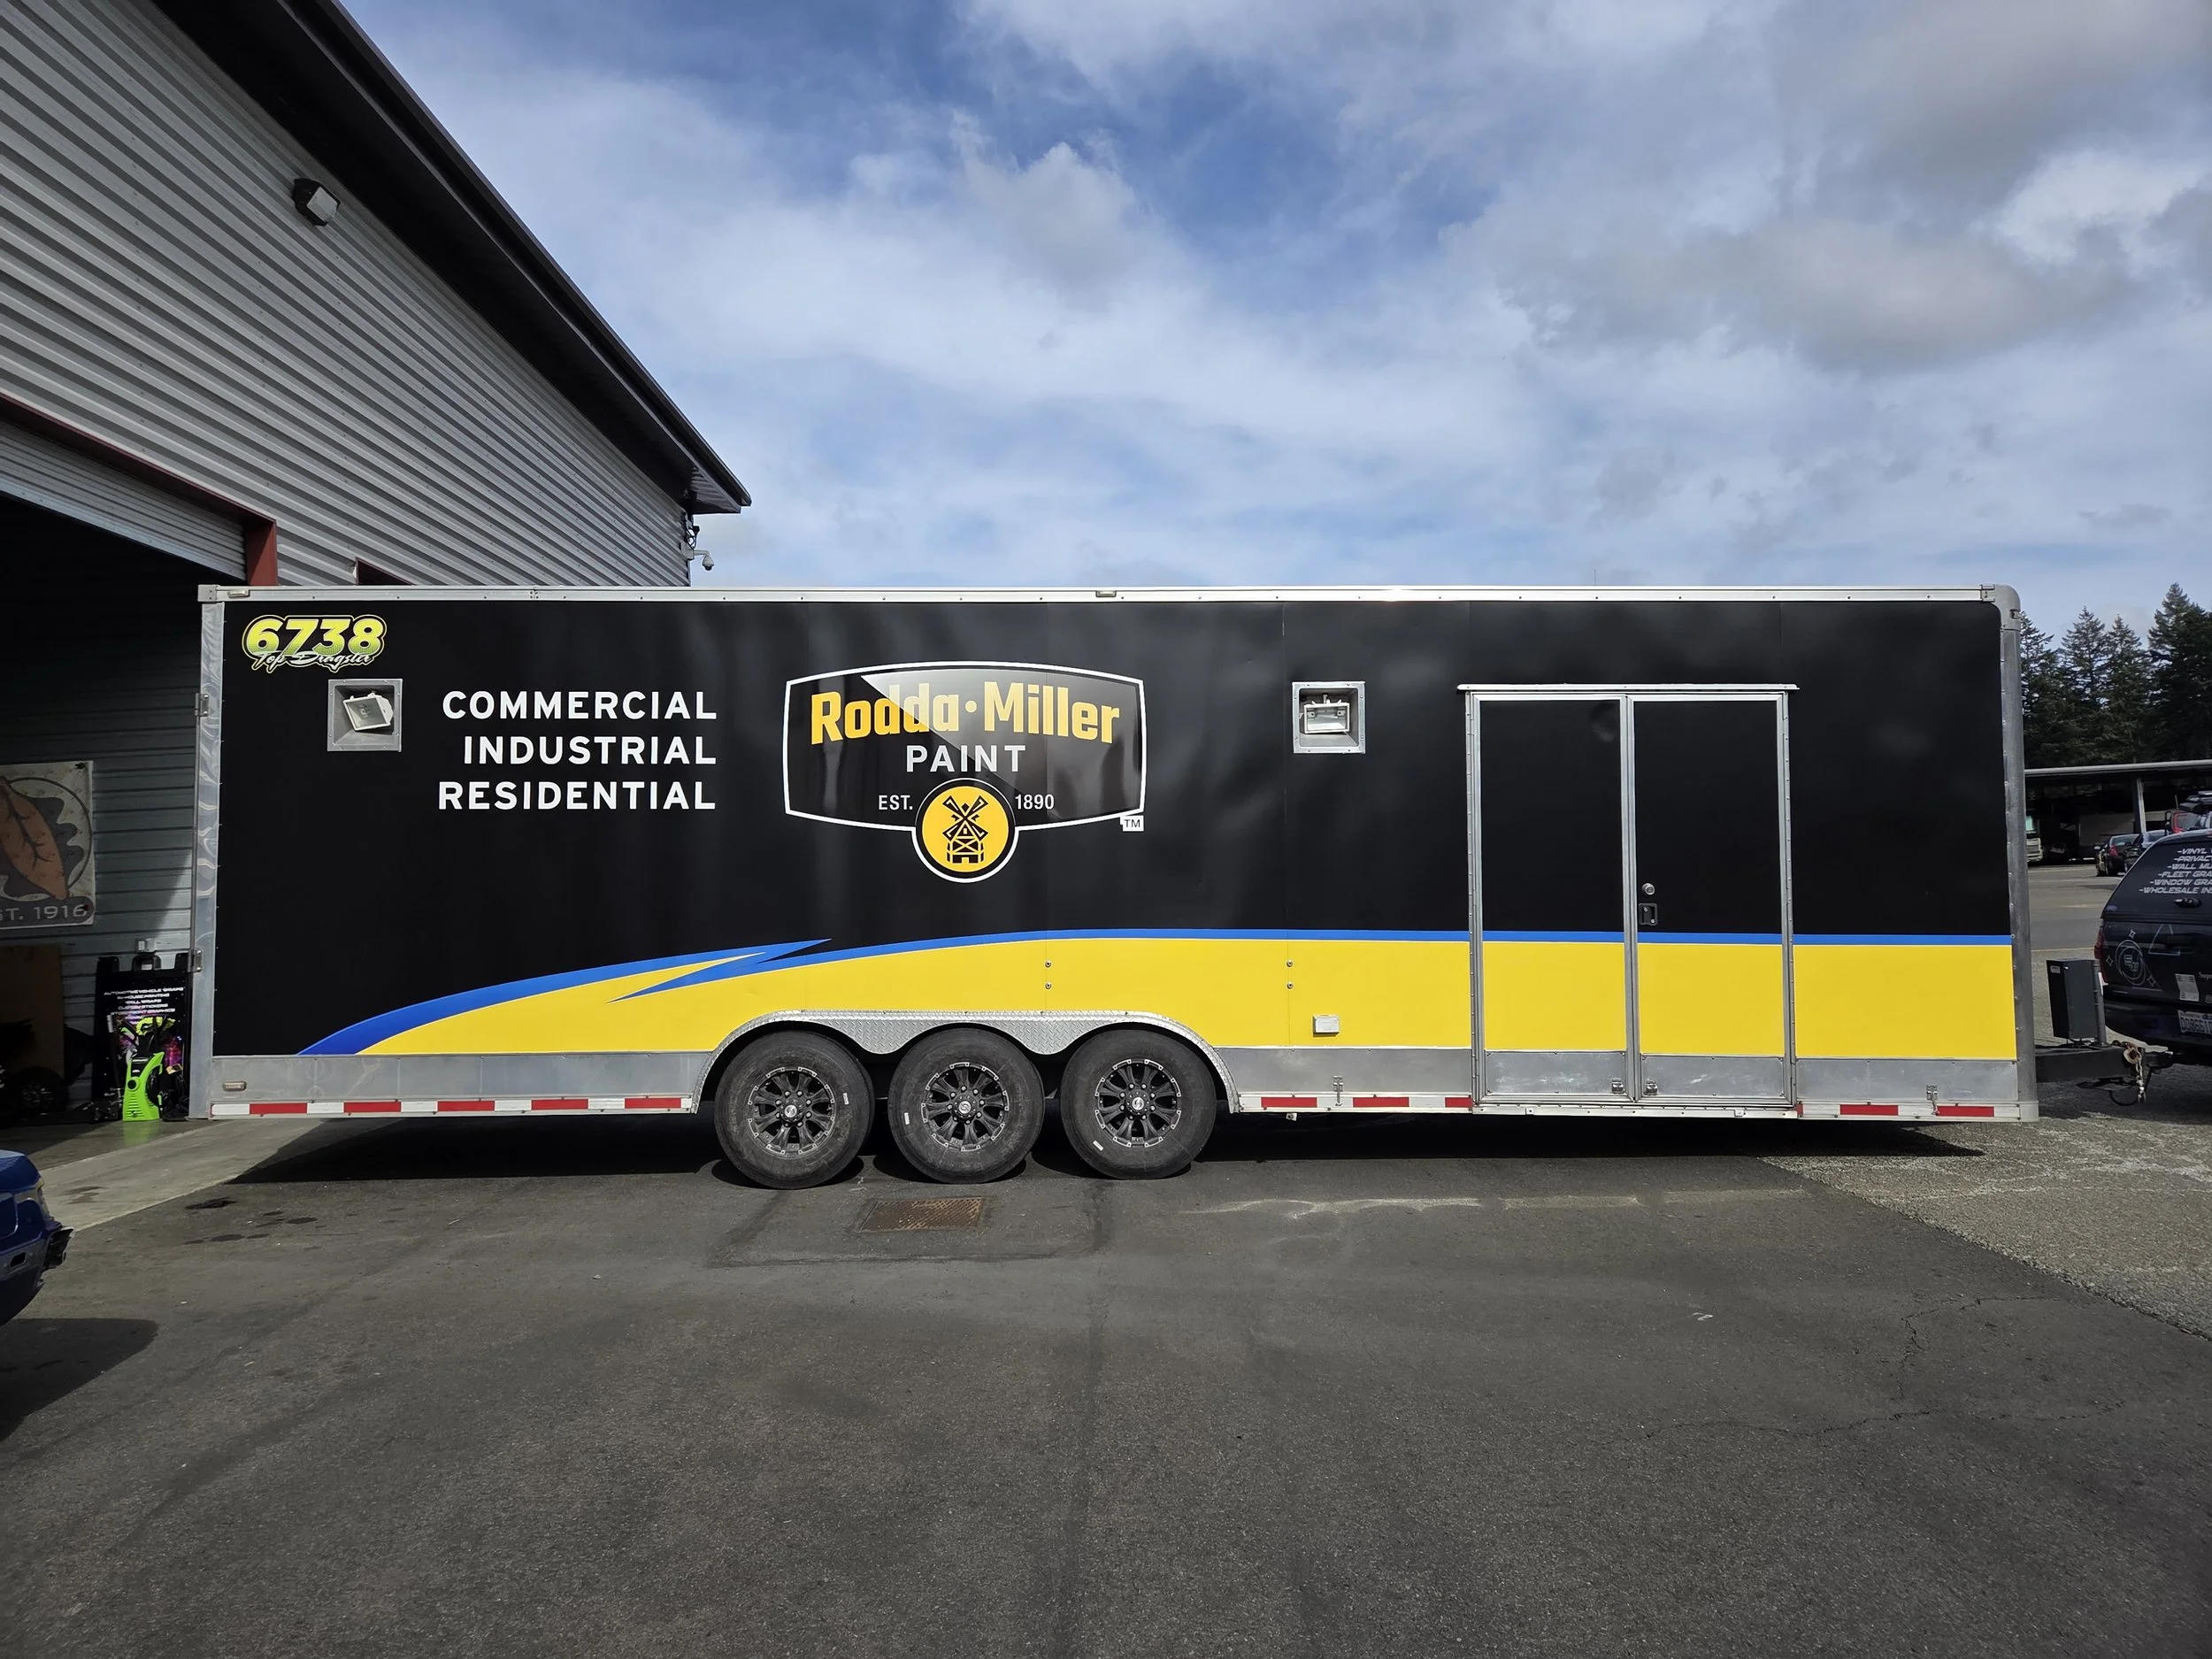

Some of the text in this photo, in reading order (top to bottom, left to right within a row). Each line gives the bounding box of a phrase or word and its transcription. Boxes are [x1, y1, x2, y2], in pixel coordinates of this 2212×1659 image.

[246, 618, 385, 657] 6738
[252, 650, 373, 671] Top Dragster
[442, 690, 718, 720] COMMERCIAL
[464, 735, 717, 765] INDUSTRIAL
[905, 744, 1026, 772] PAINT
[438, 780, 716, 810] RESIDENTIAL
[878, 793, 1055, 811] EST. 1890
[1123, 818, 1141, 828] TM
[34, 903, 88, 920] 1916
